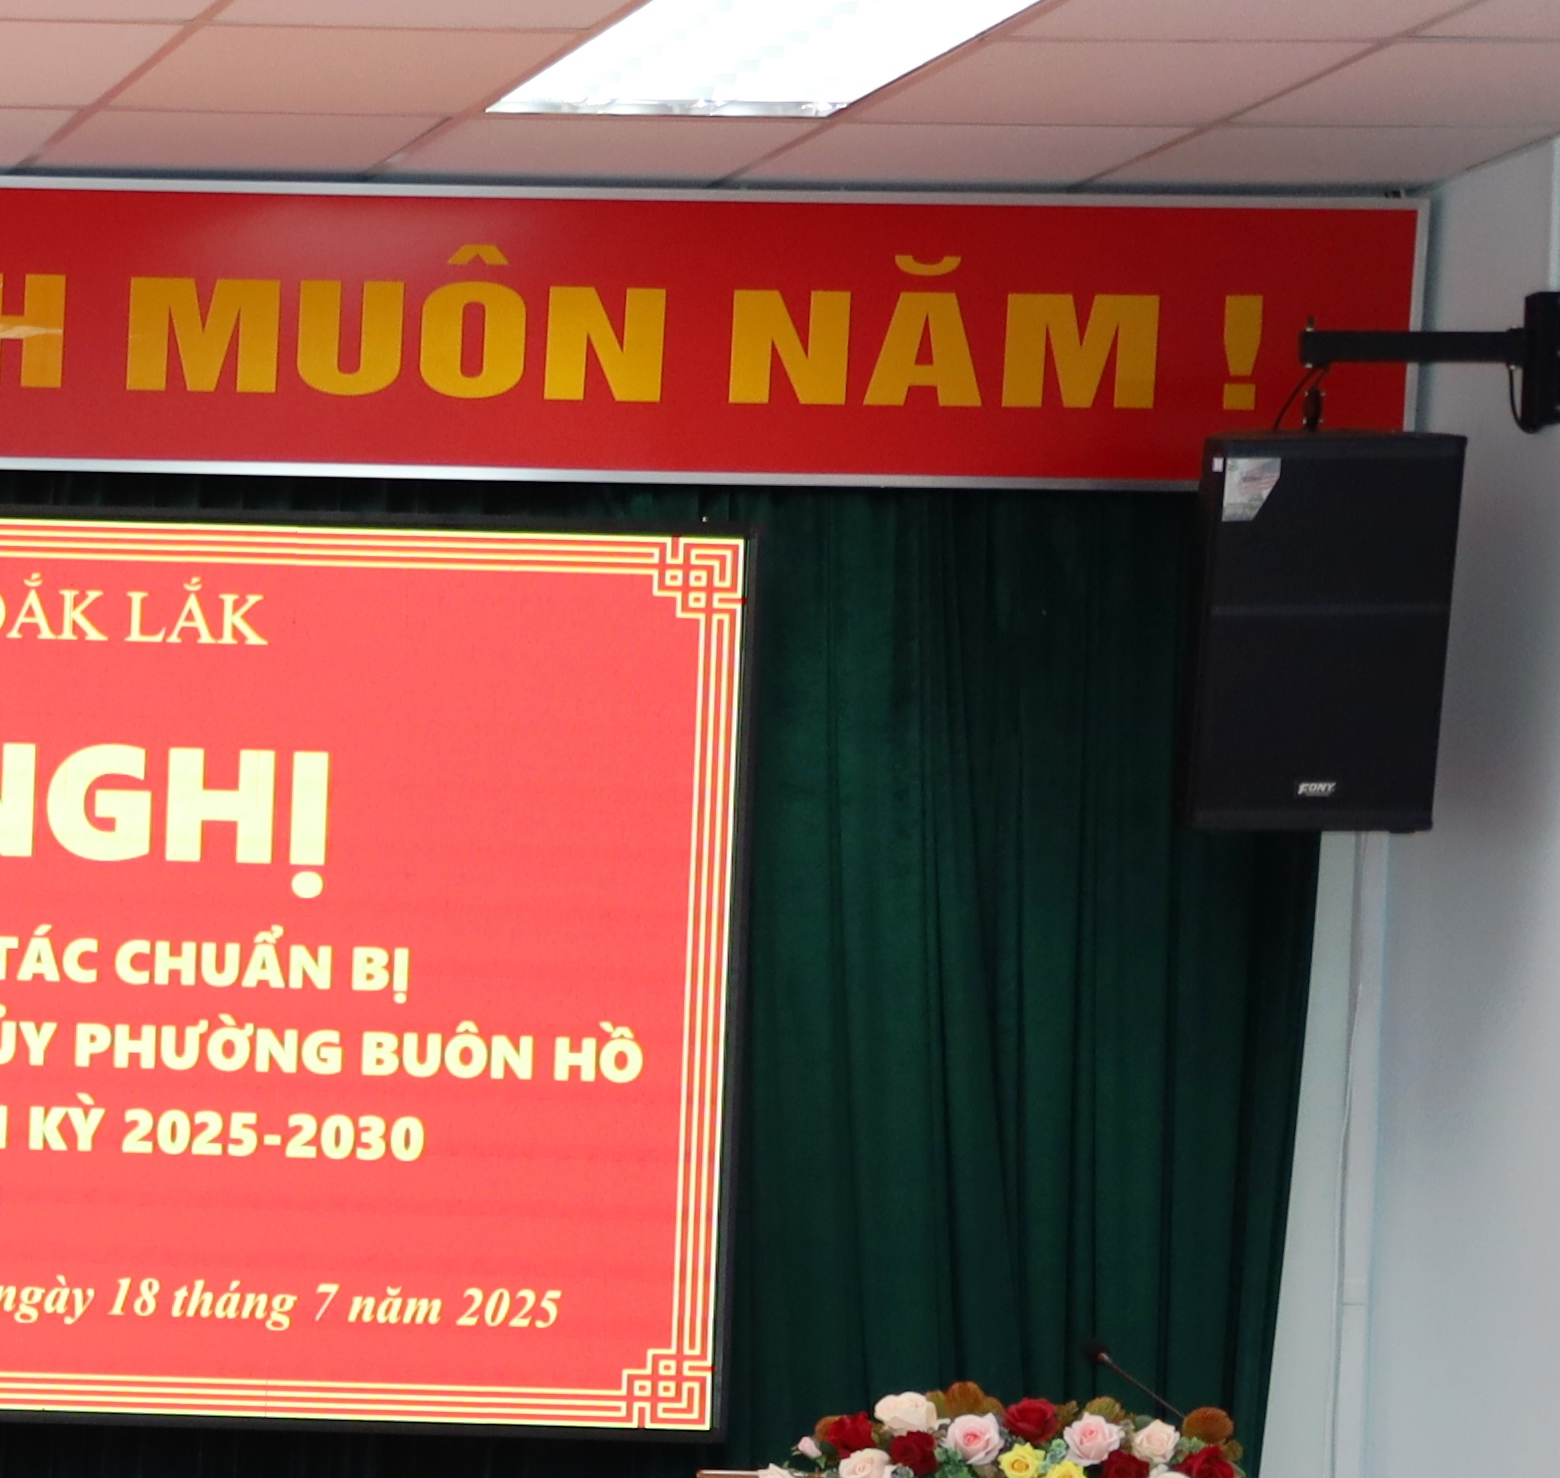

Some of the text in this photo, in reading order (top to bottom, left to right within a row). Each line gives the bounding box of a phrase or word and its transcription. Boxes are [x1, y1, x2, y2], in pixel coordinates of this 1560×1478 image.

[126, 244, 666, 402] MUÔN
[729, 256, 1158, 412] NĂM
[125, 577, 268, 645] LẮK
[1298, 782, 1336, 796] FONY
[115, 925, 332, 989] CHUẨN
[352, 946, 409, 1004] BỊ
[75, 1014, 342, 1075] PHƯỜNG
[362, 1021, 533, 1080] BUÔN
[554, 1022, 643, 1083] HỒ
[29, 1093, 105, 1151] KỲ
[122, 1108, 424, 1161] 2025-2030
[109, 1278, 160, 1316] 18
[172, 1280, 297, 1331] tháng
[316, 1283, 340, 1322] 7
[349, 1283, 441, 1324] năm
[456, 1288, 561, 1328] 2025
